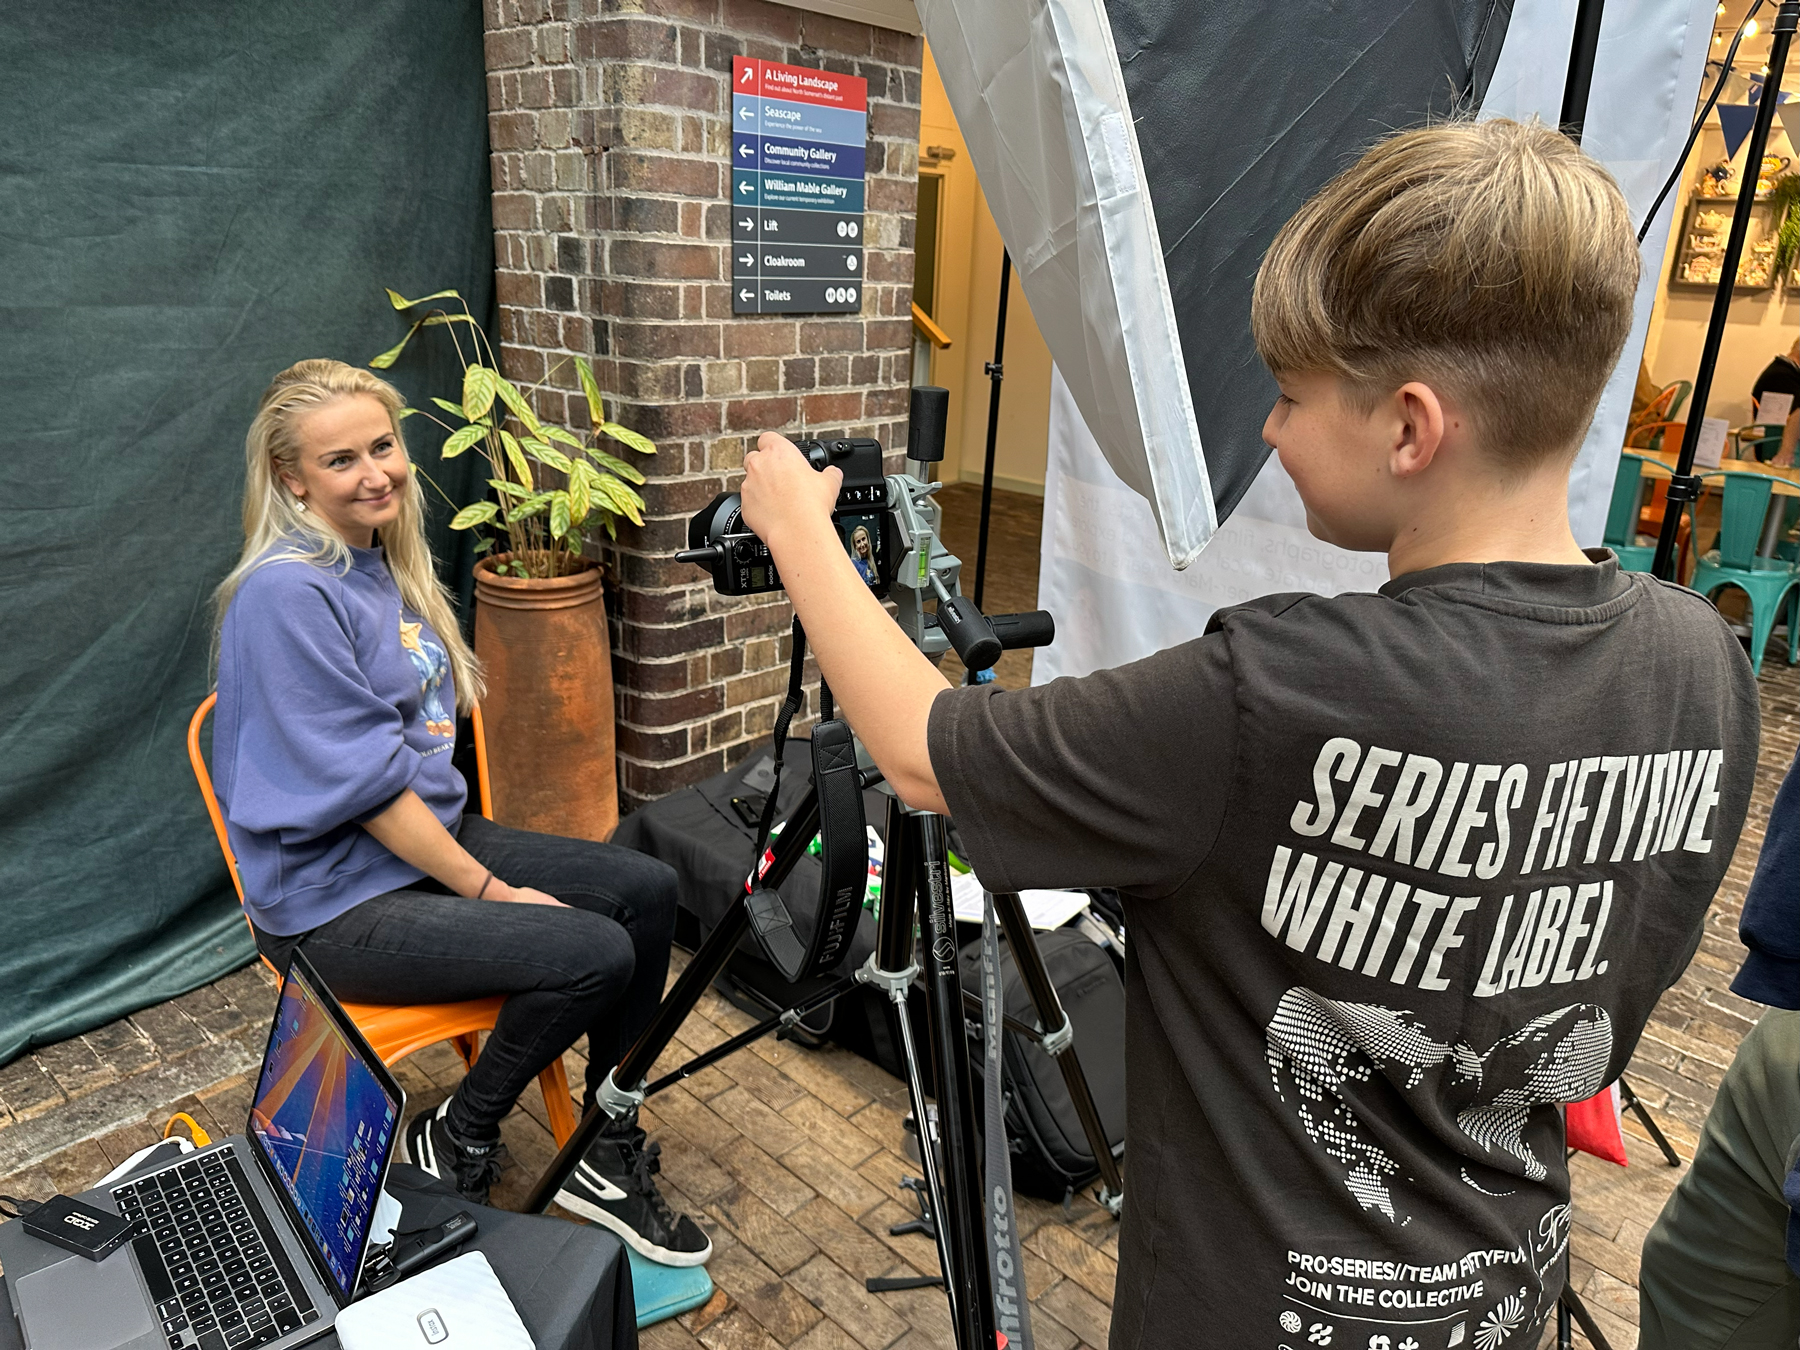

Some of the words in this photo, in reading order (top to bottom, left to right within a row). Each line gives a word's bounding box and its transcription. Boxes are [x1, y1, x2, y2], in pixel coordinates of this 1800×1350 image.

[765, 69, 772, 80] A
[773, 70, 798, 87] Living
[799, 74, 838, 92] Landscape
[764, 106, 801, 122] Seascape
[764, 120, 785, 129] Experience
[764, 142, 809, 160] Community
[810, 148, 837, 164] Gallery
[790, 160, 811, 169] community
[811, 162, 830, 170] collections
[764, 179, 795, 192] William
[796, 181, 820, 194] Mable
[821, 184, 847, 198] Gallery
[799, 196, 817, 204] temporary
[764, 219, 778, 232] Lift
[764, 254, 805, 268] Cloakroom
[764, 289, 791, 302] Toilets
[420, 748, 433, 758] OLO
[433, 742, 449, 755] BEAR
[1290, 737, 1528, 880] SERIES
[1520, 749, 1724, 874] FIFTYFIVE
[924, 860, 946, 935] silvestri
[819, 886, 854, 964] FUJIFILM
[1261, 845, 1481, 992] WHITE
[1472, 880, 1614, 998] LABEL.
[993, 1184, 1023, 1350] nfrotto
[1285, 1271, 1332, 1301] JOIN
[1336, 1284, 1375, 1306] THE
[1378, 1280, 1484, 1309] COLLECTIVE
